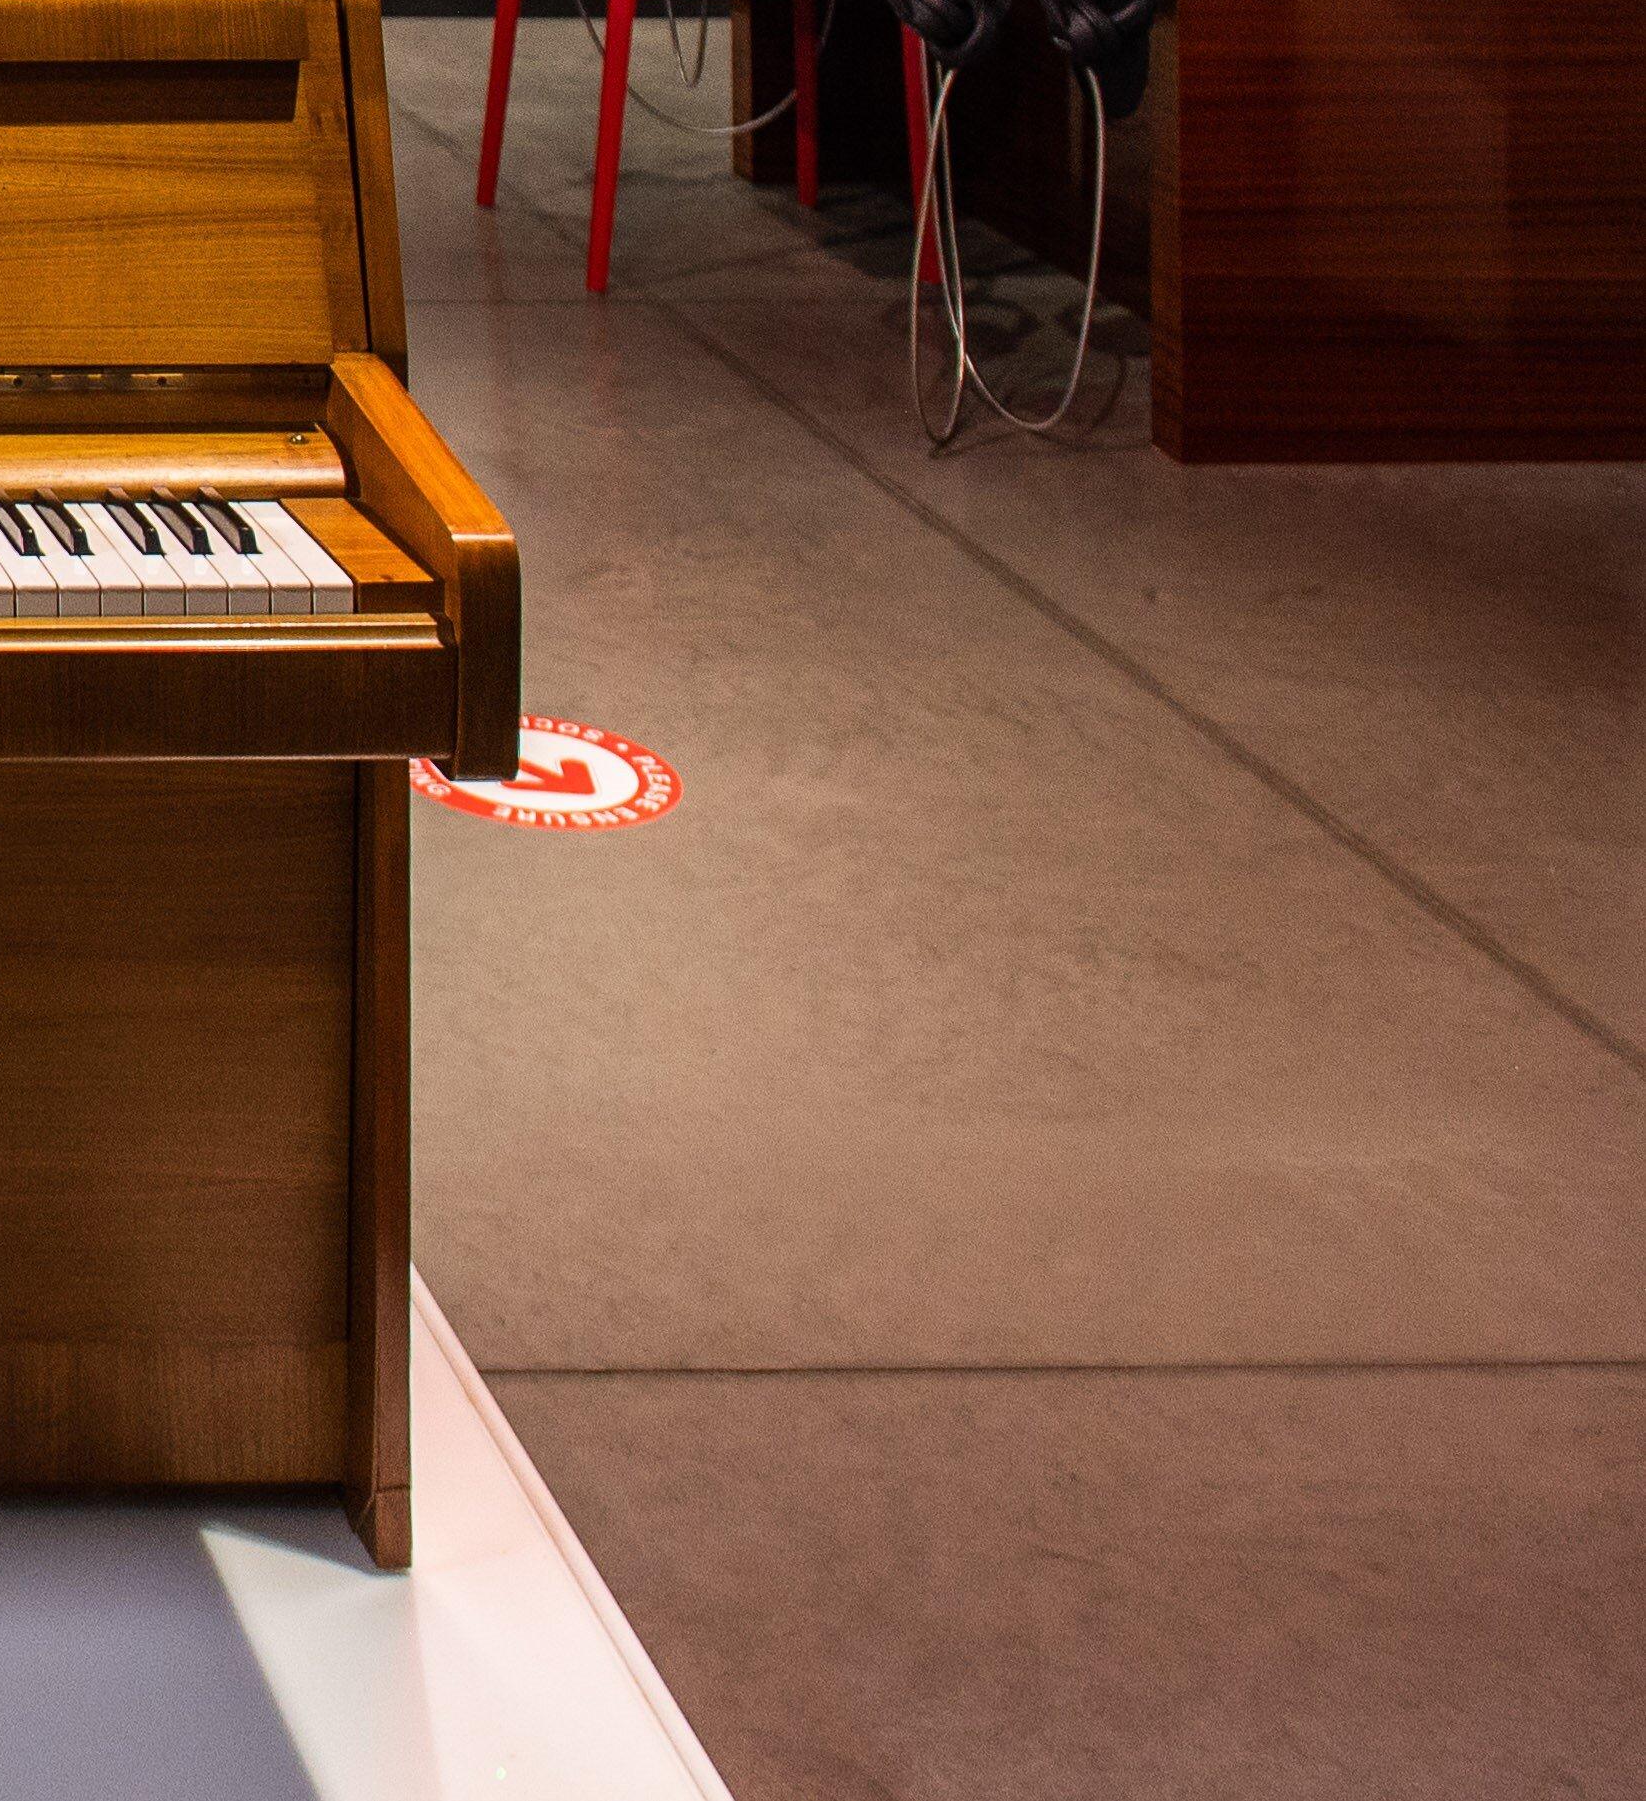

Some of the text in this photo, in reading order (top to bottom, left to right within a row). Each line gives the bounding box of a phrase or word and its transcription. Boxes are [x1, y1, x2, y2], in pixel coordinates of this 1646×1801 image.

[519, 714, 605, 742] SOCI
[492, 754, 673, 828] PLEASE ENSURE
